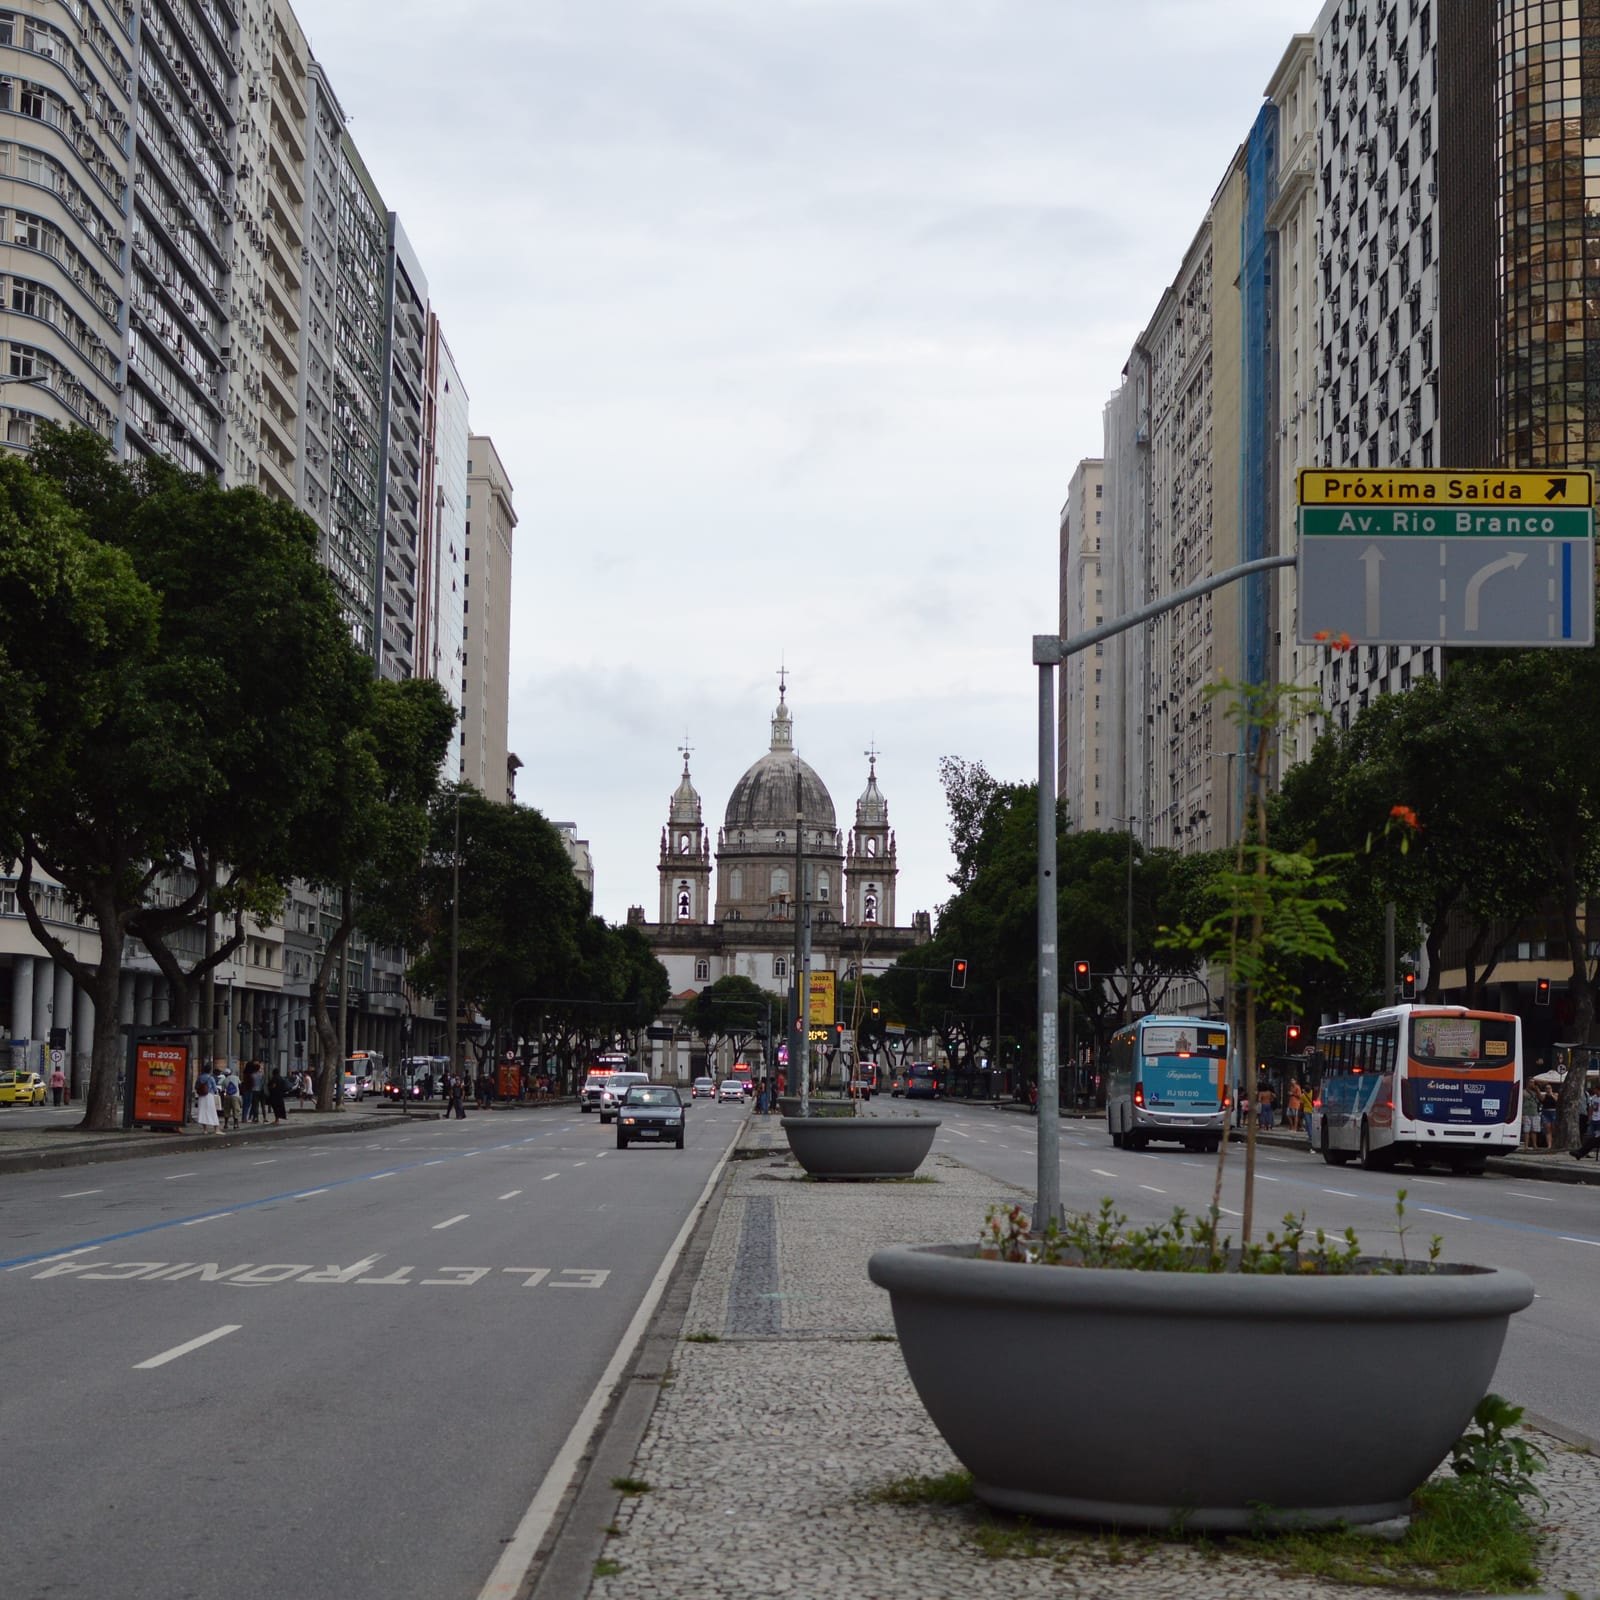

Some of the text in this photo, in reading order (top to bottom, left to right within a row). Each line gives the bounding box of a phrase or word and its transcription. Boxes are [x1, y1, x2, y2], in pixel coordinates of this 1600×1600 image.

[1324, 477, 1522, 499] Próxima Saída
[1338, 512, 1555, 533] Av. Rio Branco
[143, 1050, 182, 1061] Em 2022,
[148, 1061, 175, 1072] VIVA
[1436, 1082, 1459, 1090] ideal
